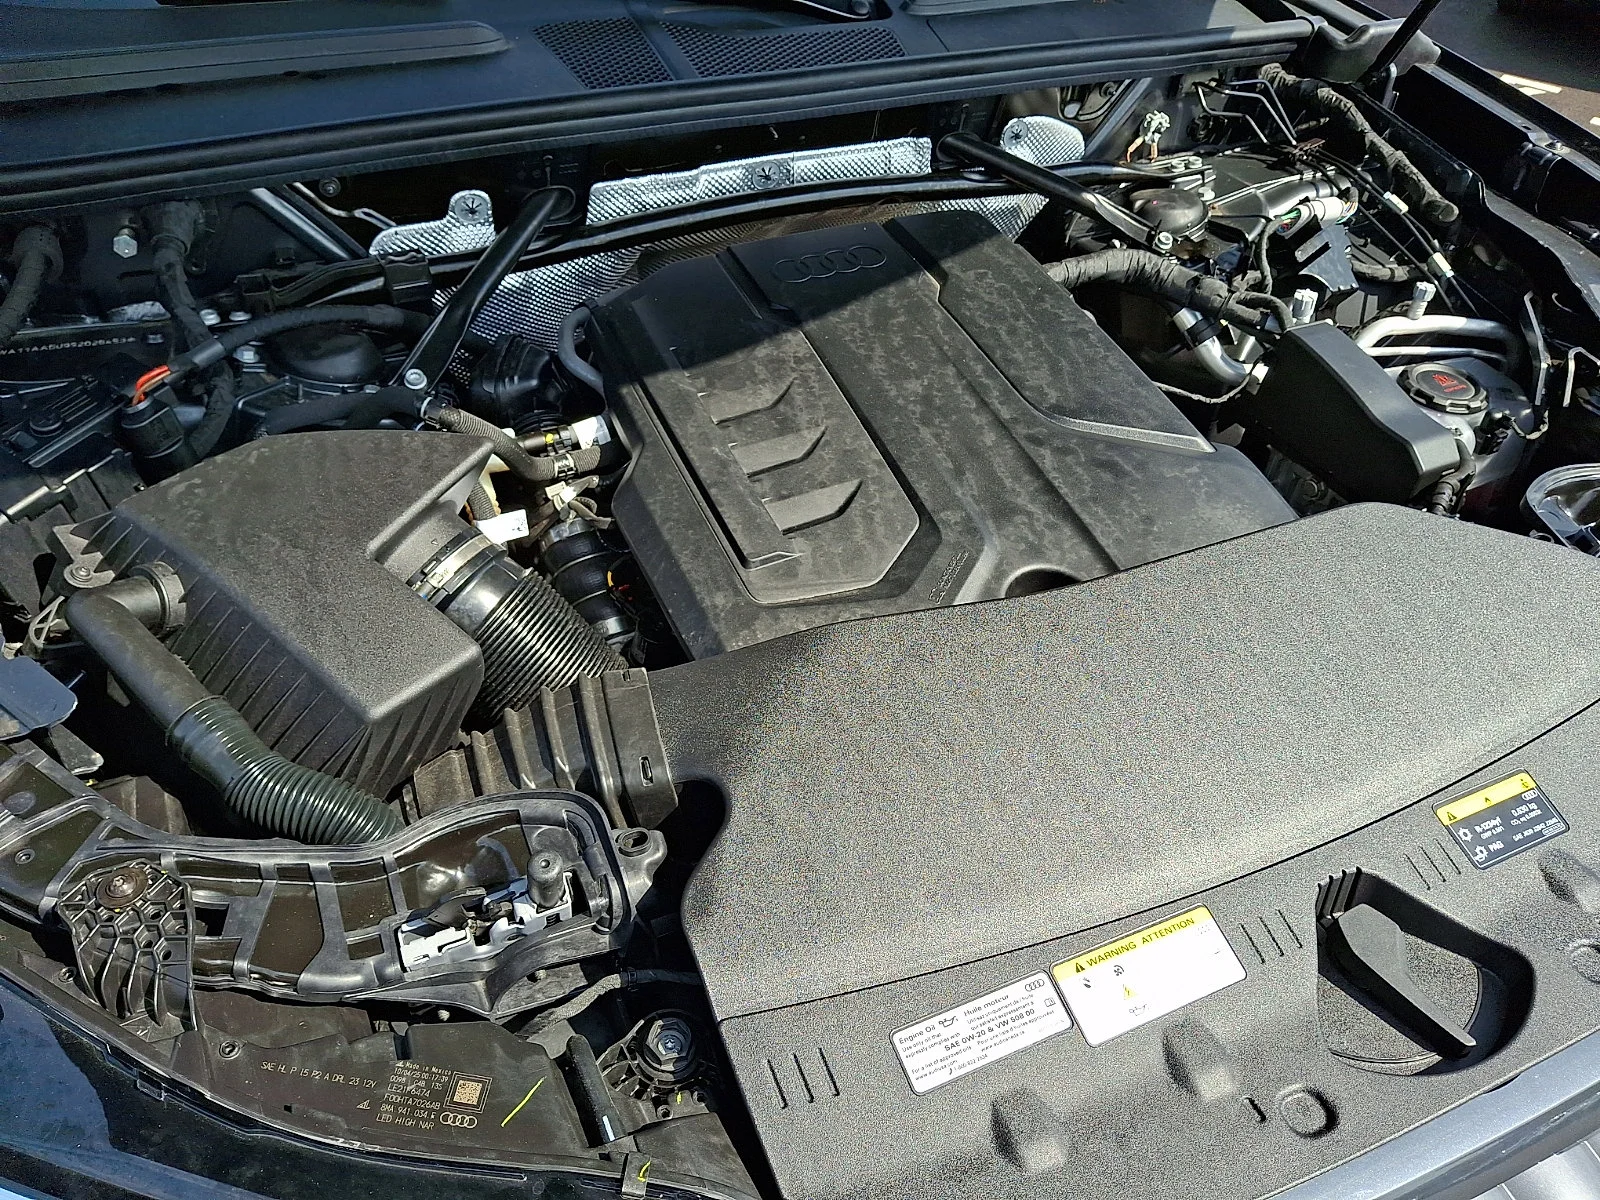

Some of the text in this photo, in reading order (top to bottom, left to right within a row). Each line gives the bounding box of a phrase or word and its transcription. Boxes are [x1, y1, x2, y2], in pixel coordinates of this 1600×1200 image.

[1086, 917, 1195, 968] WARNING ATTENTION
[963, 994, 1009, 1017] Huile moteur
[899, 1024, 936, 1045] Engine Oil
[944, 1040, 961, 1051] SAE
[961, 1029, 986, 1043] 0W-20
[995, 1019, 1009, 1028] VW
[1010, 1012, 1024, 1023] 508
[1025, 1008, 1035, 1016] 00
[906, 1047, 928, 1058] expressly
[929, 1038, 949, 1049] complies
[940, 1049, 962, 1062] approved
[261, 1061, 377, 1089] SAE HL P 15 P2 A DRL 23 12V
[405, 1061, 420, 1070] Made
[431, 1066, 452, 1075] Mexico
[375, 1112, 435, 1130] LED HIGH NAR
